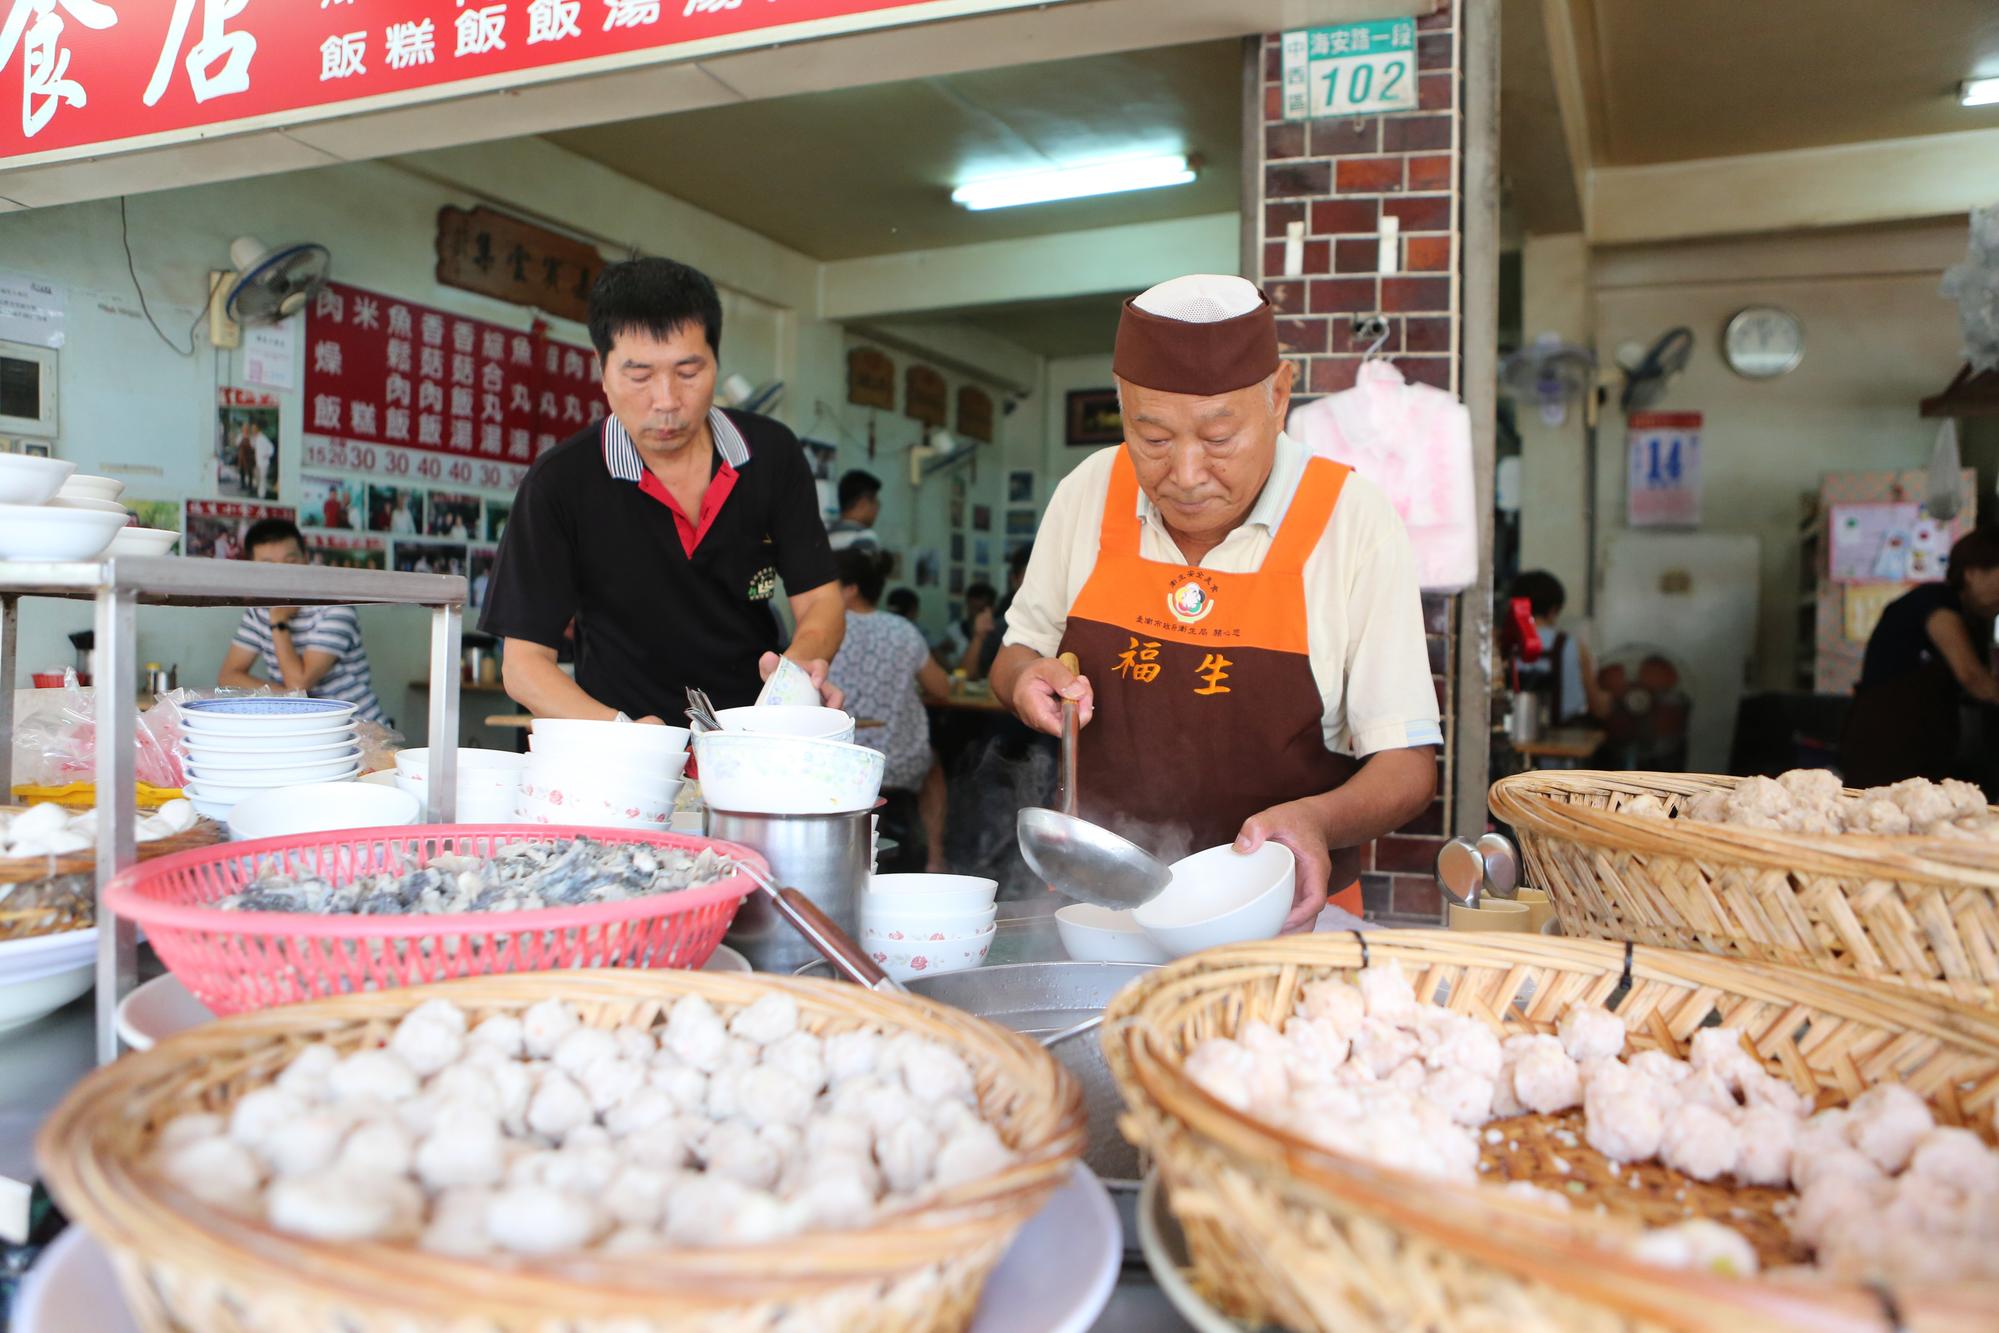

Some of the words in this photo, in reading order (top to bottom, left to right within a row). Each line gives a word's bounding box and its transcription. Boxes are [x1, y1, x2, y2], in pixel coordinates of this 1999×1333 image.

[1310, 22, 1412, 55] 海安路一段
[1321, 60, 1406, 107] 102
[385, 449, 409, 475] 30
